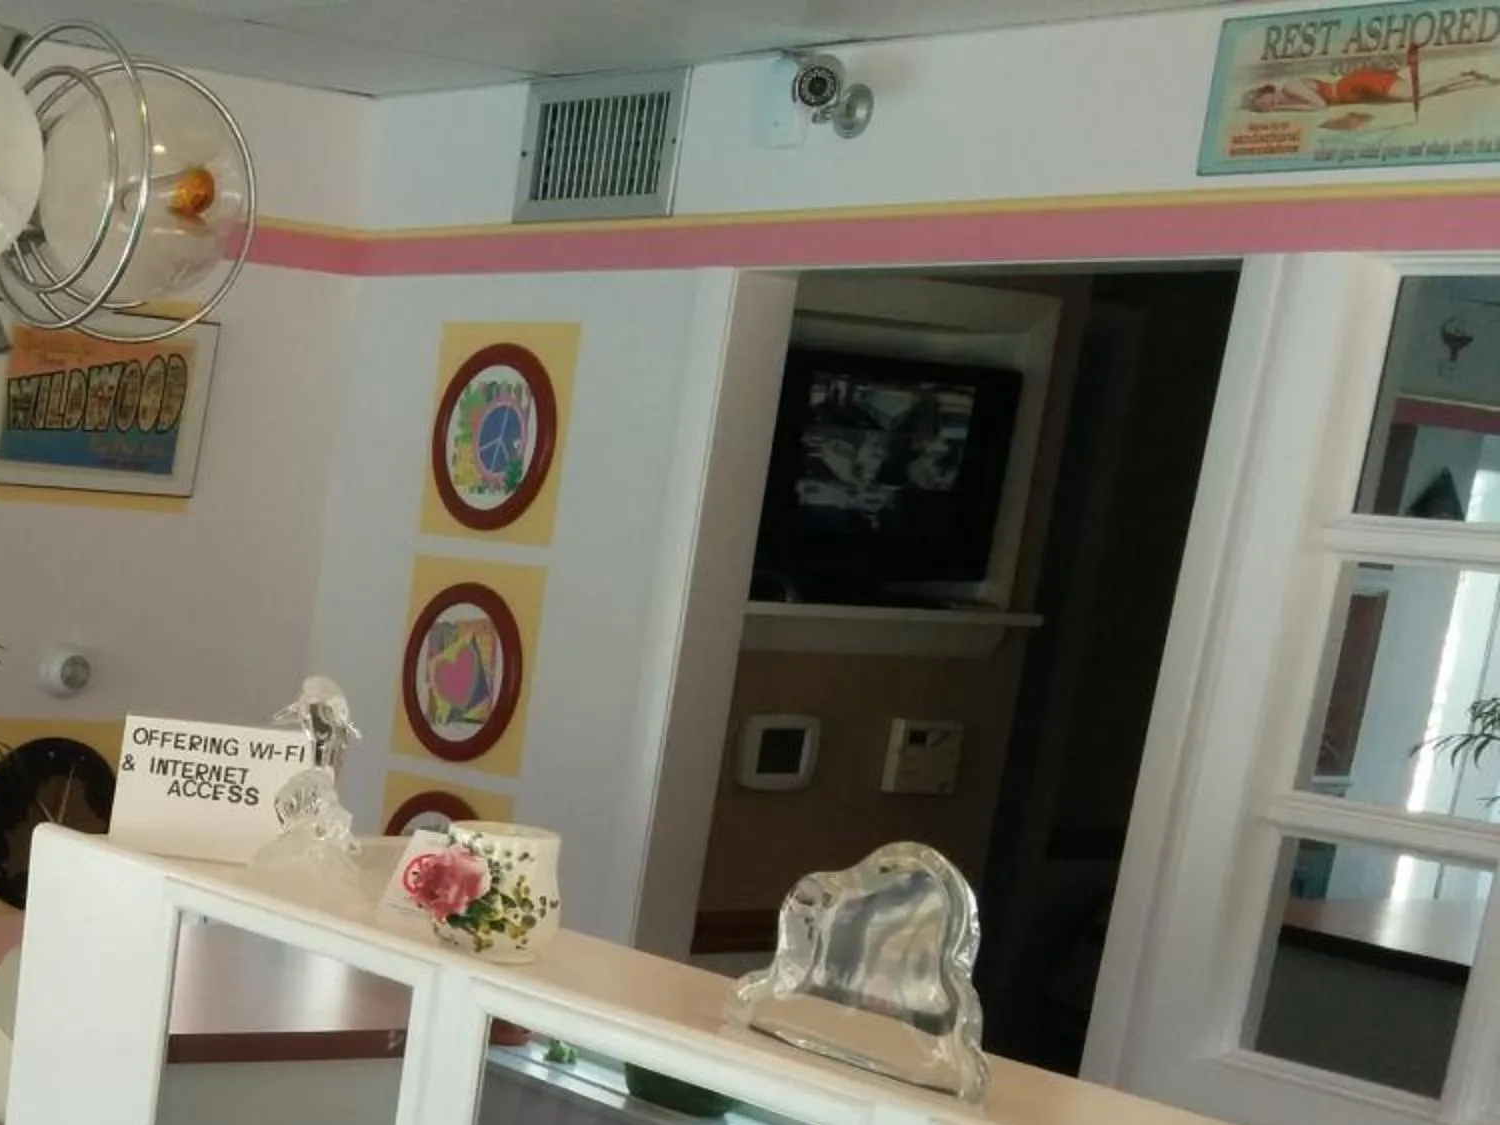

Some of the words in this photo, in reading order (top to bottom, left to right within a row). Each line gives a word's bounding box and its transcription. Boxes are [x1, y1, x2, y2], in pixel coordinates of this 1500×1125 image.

[1261, 20, 1341, 61] REST
[8, 353, 188, 434] WILDWOOD
[133, 727, 239, 757] OFFERING
[250, 741, 306, 763] WI-FI
[122, 753, 136, 772] &
[149, 756, 250, 785] INTERNET
[167, 780, 260, 806] ACCESS
